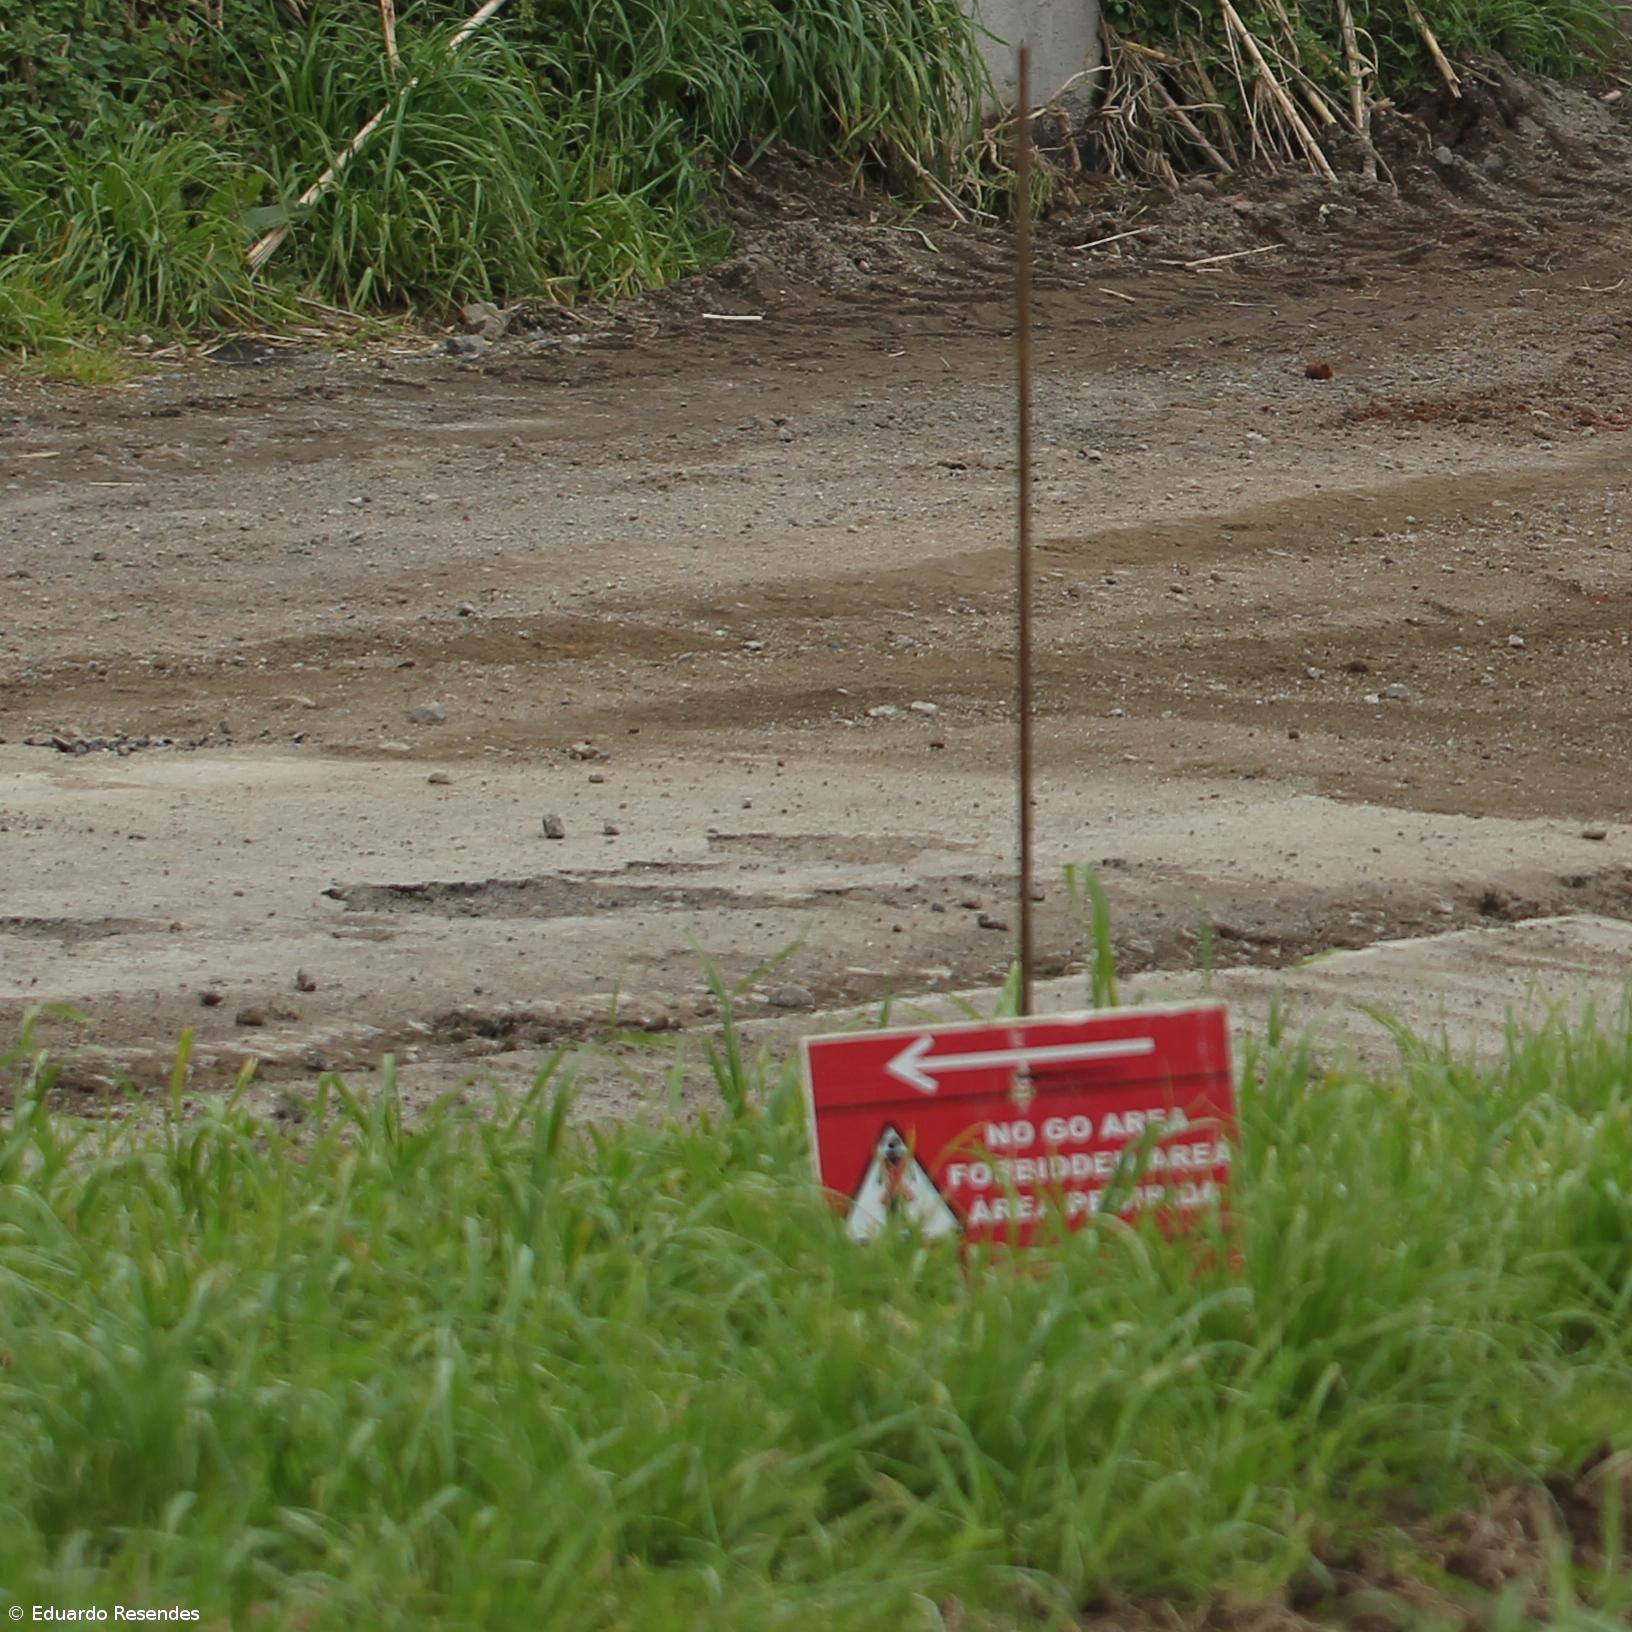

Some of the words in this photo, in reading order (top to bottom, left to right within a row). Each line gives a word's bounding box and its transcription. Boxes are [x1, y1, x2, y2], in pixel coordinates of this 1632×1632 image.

[985, 1119, 1035, 1148] NO
[1043, 1115, 1093, 1144] GO
[1100, 1107, 1190, 1139] AREA
[1147, 1140, 1233, 1170] AREA
